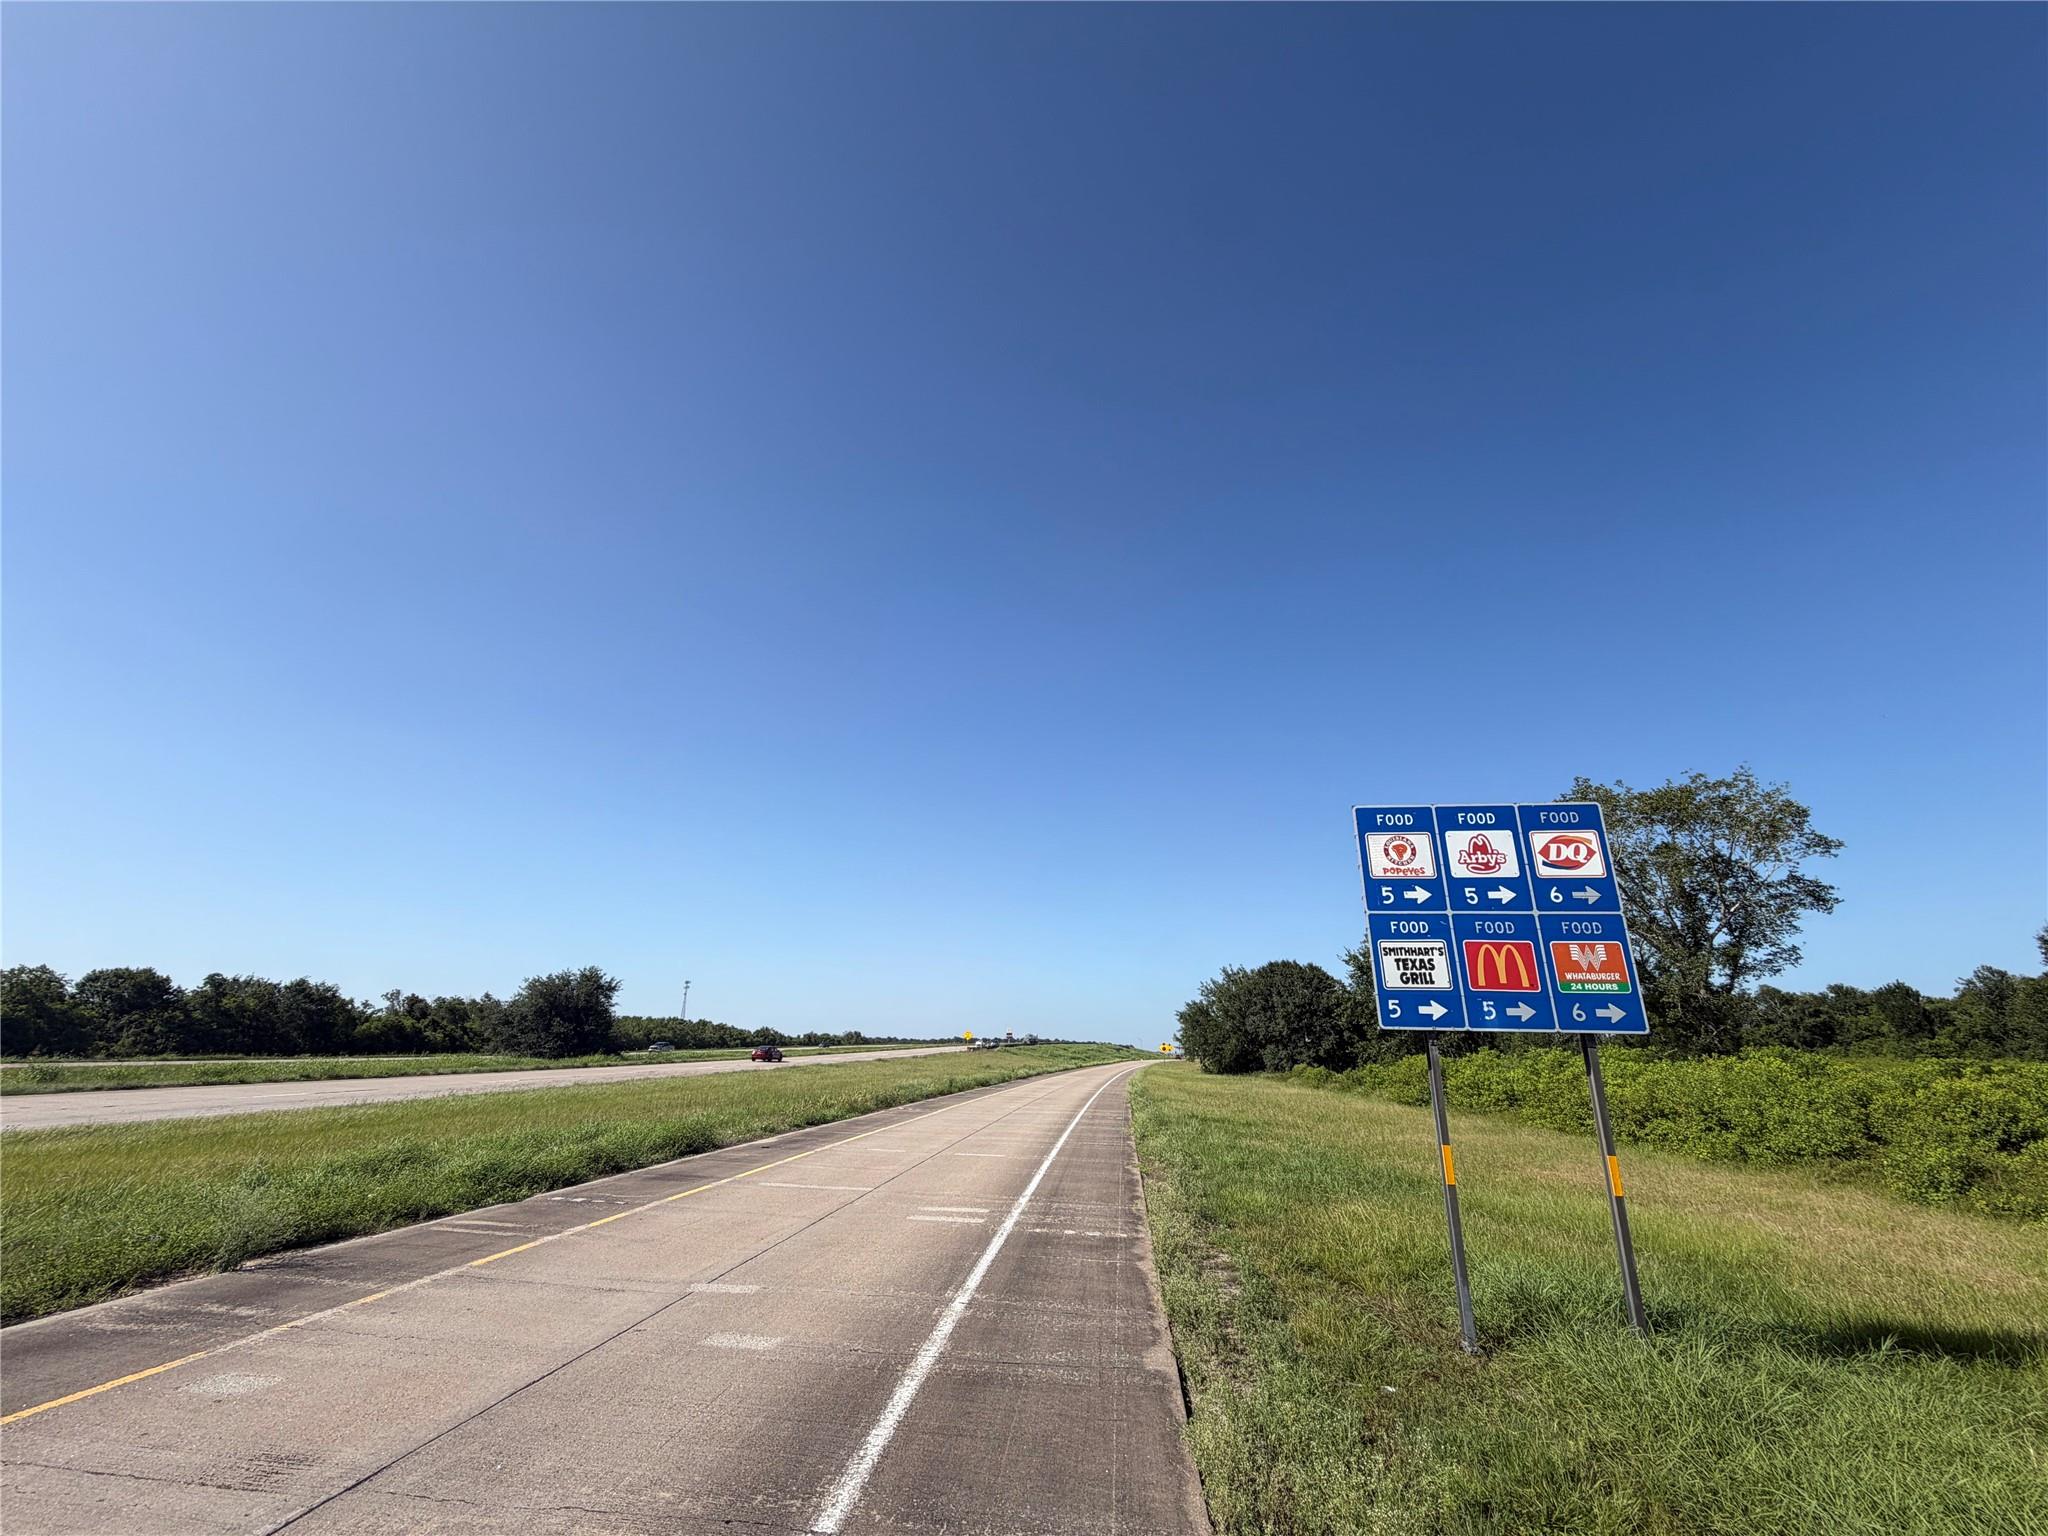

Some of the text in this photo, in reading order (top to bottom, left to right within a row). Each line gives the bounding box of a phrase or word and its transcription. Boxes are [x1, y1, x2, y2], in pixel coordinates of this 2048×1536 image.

[1376, 814, 1414, 826] FOOD
[1457, 812, 1496, 824] FOOD
[1539, 811, 1580, 824] FOOD
[1458, 849, 1507, 866] Arby's
[1547, 842, 1589, 863] DQ
[1381, 886, 1395, 905] 5
[1464, 887, 1479, 905] 5
[1550, 886, 1563, 903] 6
[1390, 921, 1429, 934] FOOD
[1474, 921, 1515, 934] FOOD
[1561, 921, 1603, 935] FOOD
[1382, 946, 1444, 957] SMITHHART'S
[1394, 958, 1436, 971] TEXAS
[1399, 972, 1436, 985] GRILL
[1564, 972, 1621, 981] WHATABURGER
[1570, 983, 1619, 991] 24 HOURS
[1388, 999, 1402, 1019] 5
[1482, 1001, 1497, 1020] 5
[1572, 1002, 1587, 1022] 6
